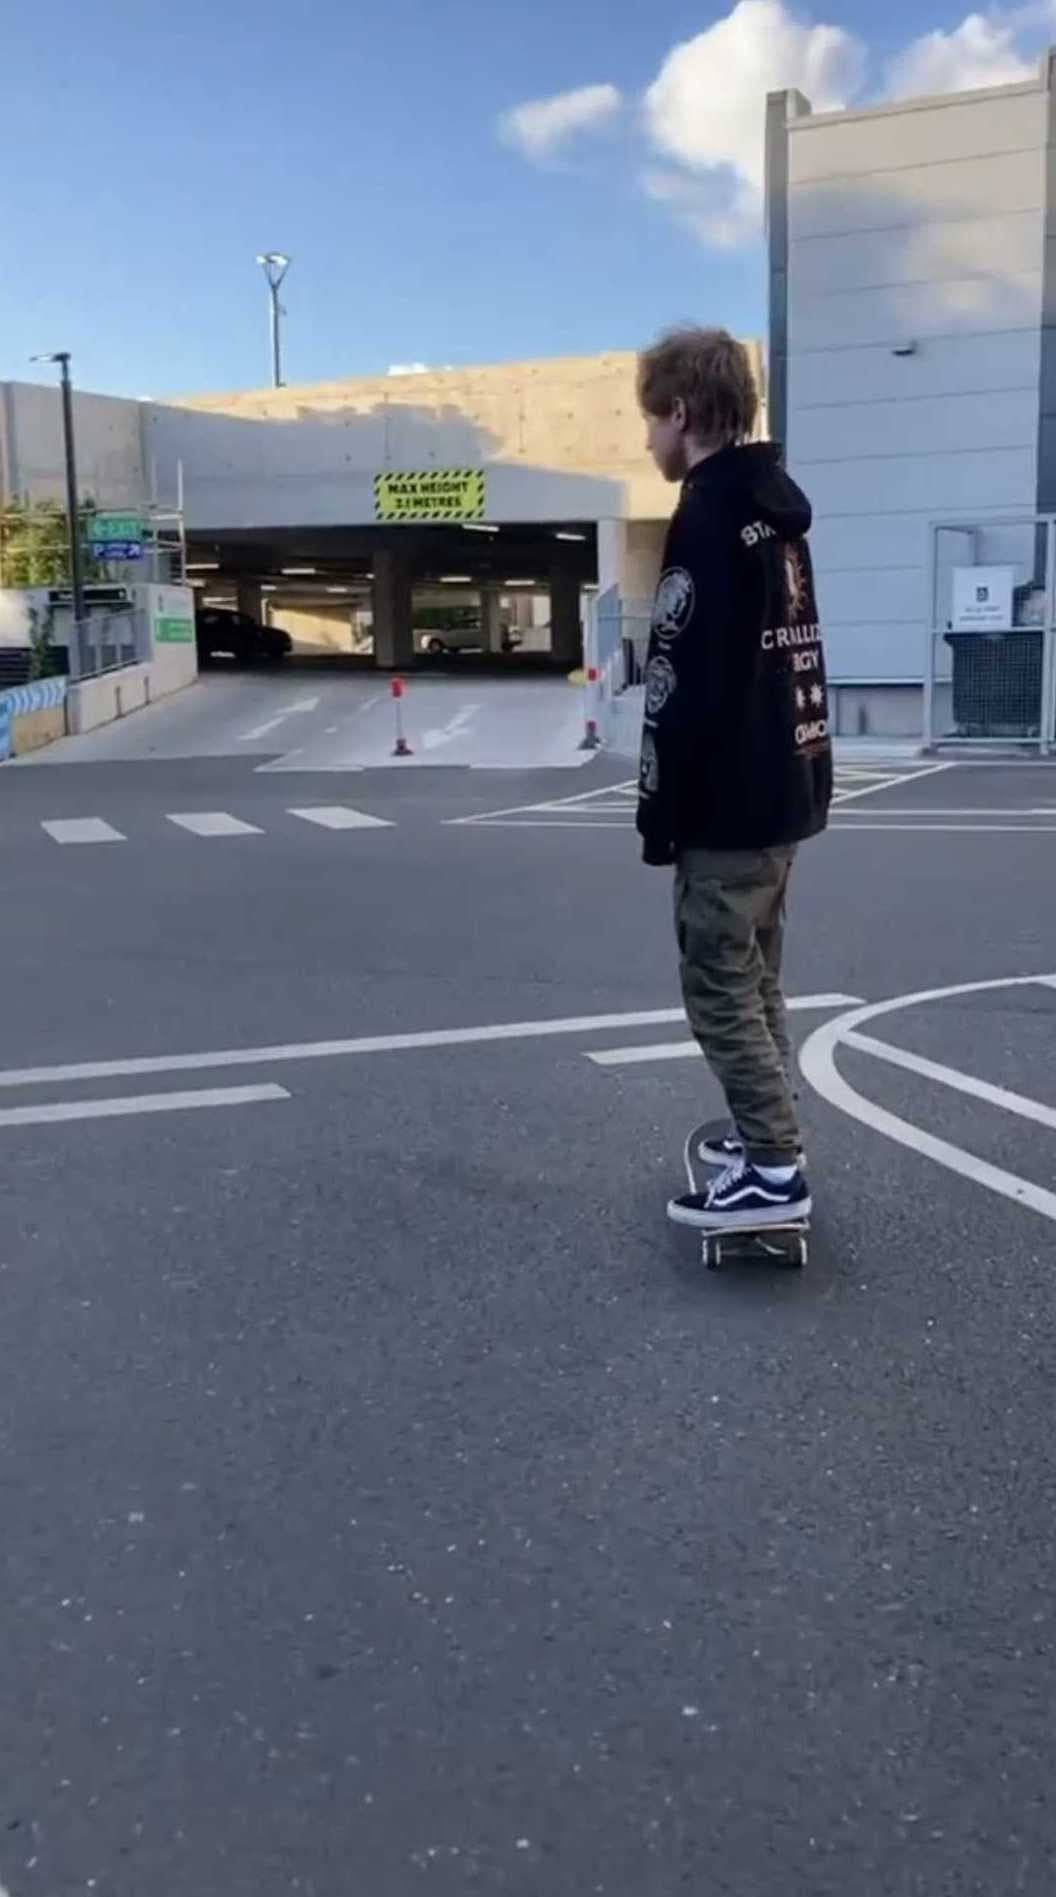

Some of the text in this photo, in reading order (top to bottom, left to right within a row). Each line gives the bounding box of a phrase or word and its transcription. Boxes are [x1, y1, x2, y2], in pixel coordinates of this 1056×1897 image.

[388, 481, 468, 495] MAX HEIGHT
[413, 496, 462, 509] METRES
